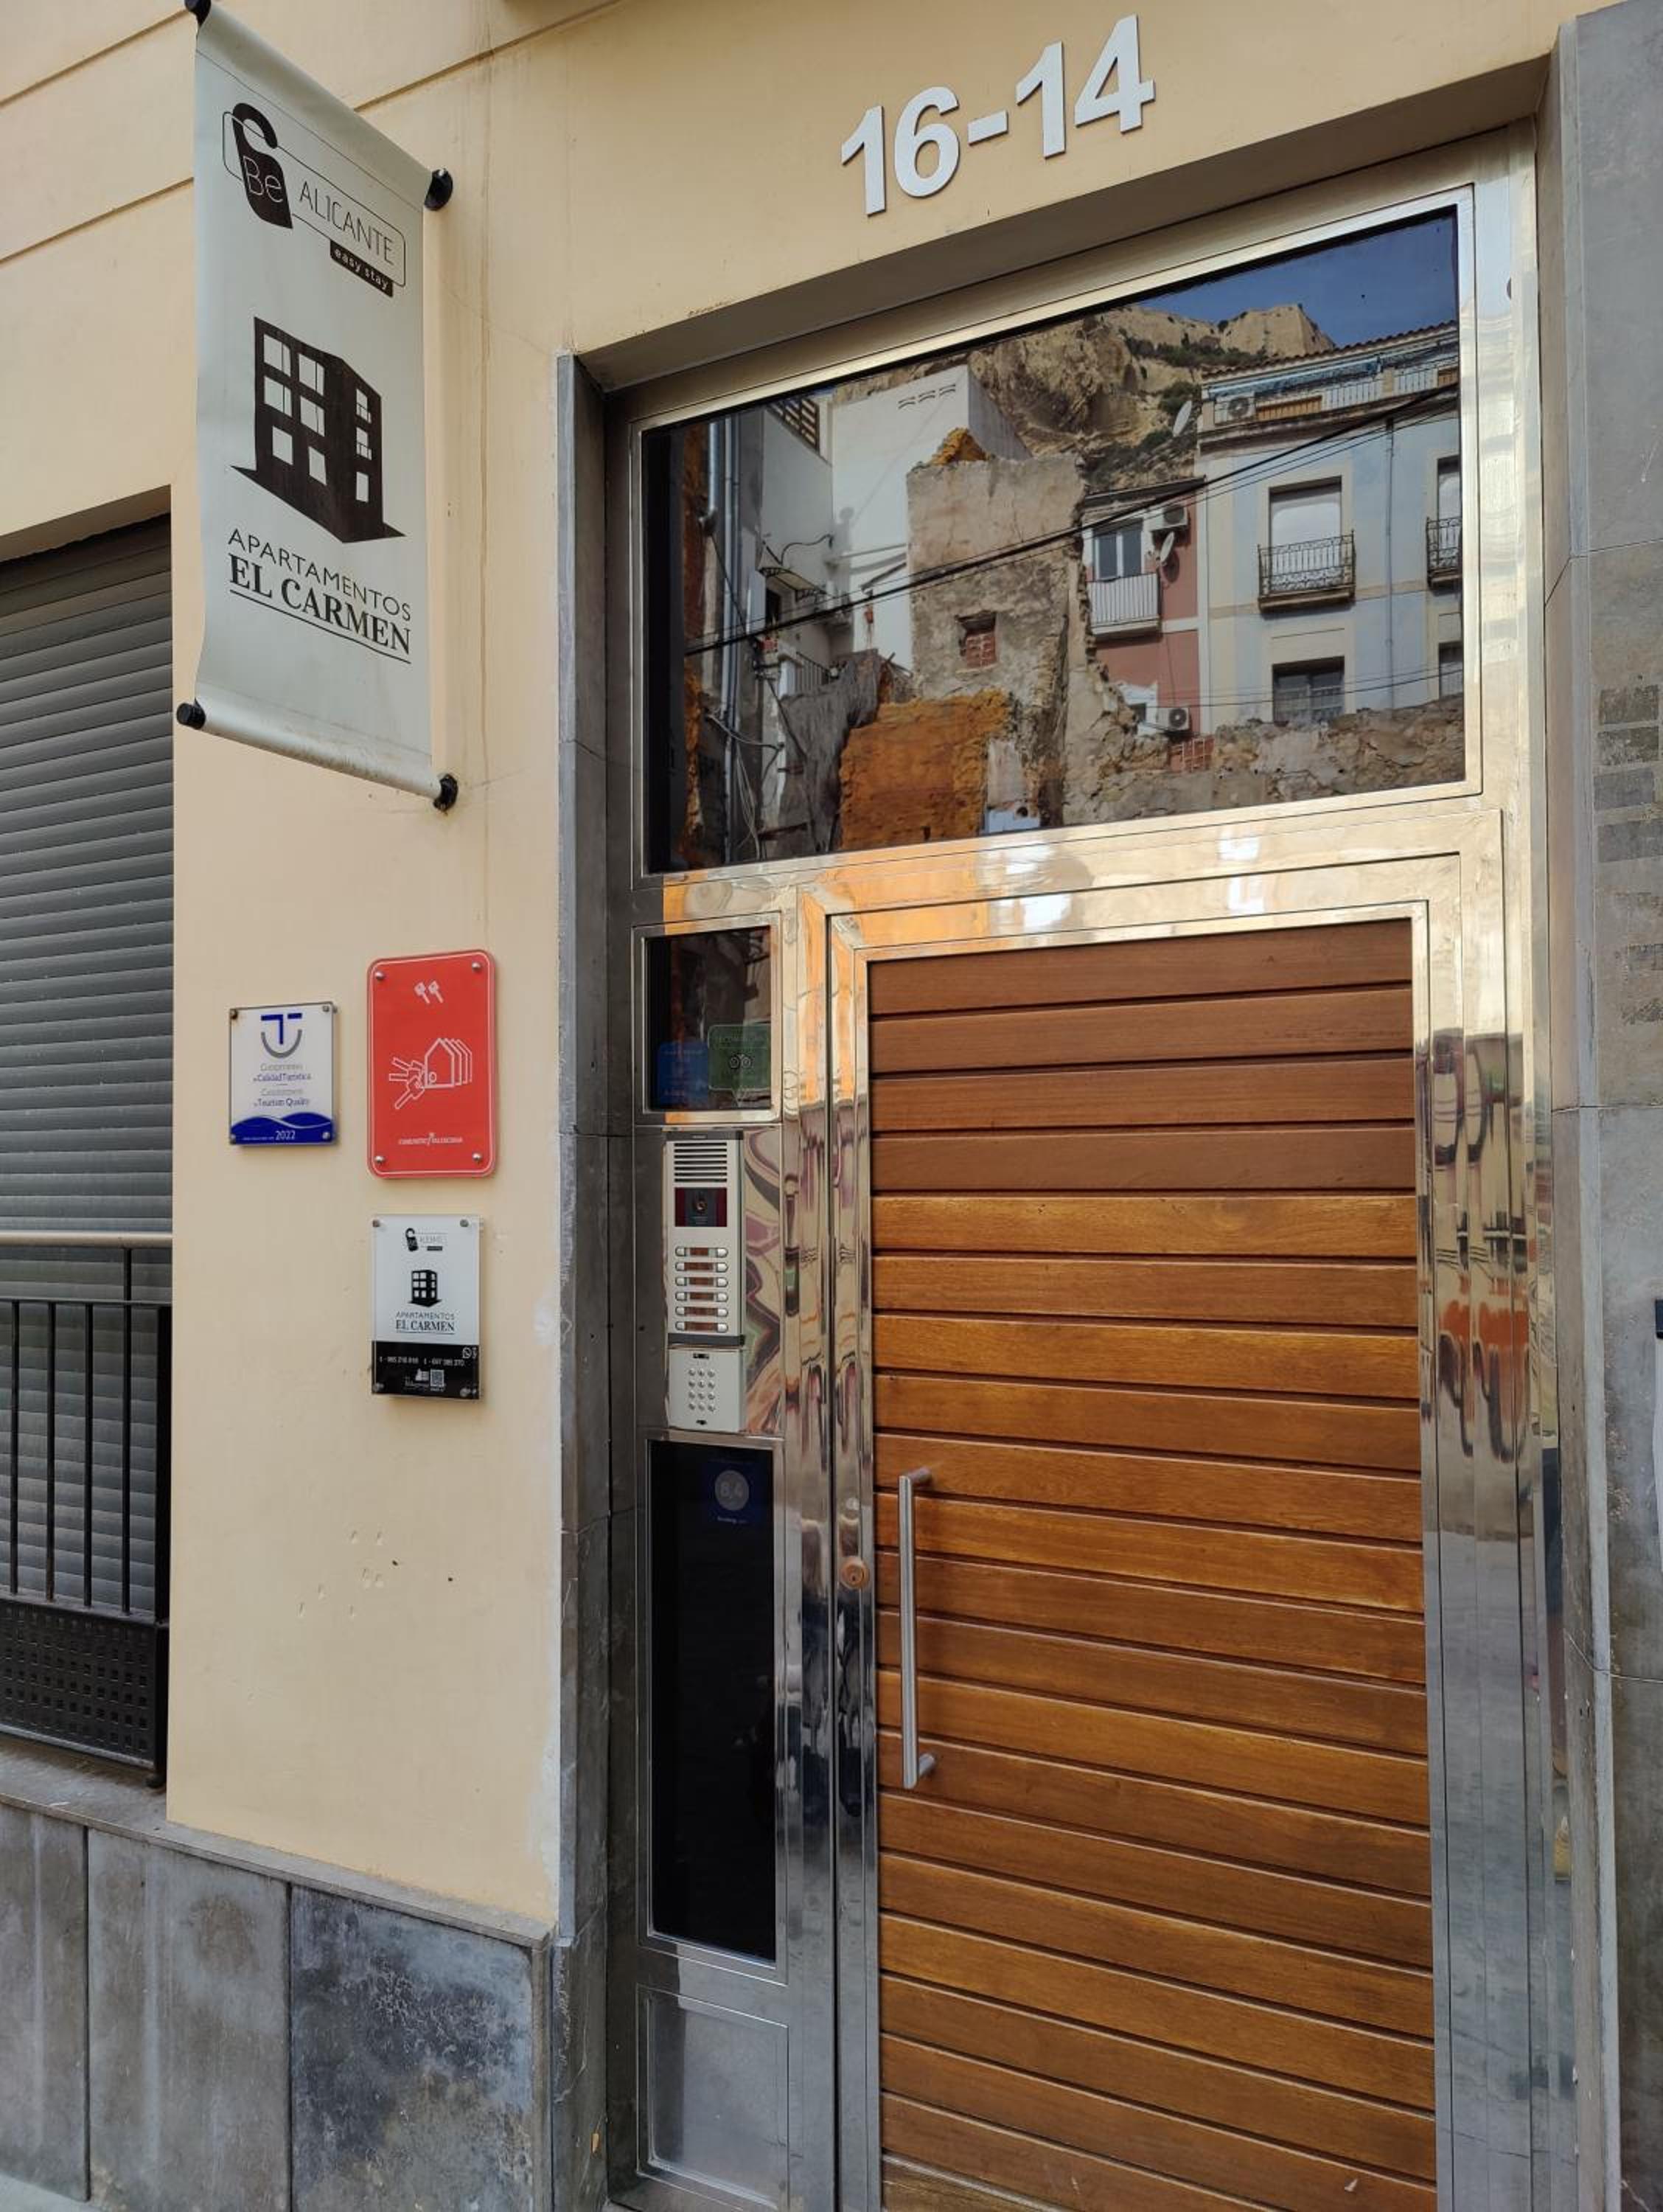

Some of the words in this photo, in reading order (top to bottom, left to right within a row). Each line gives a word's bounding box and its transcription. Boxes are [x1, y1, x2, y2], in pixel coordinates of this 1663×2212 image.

[841, 13, 1156, 217] 16-14
[243, 156, 284, 203] Be
[299, 181, 394, 266] ALICANTE
[334, 248, 361, 273] easy
[365, 268, 388, 290] stay
[228, 528, 411, 622] APARTAMENTOS
[228, 552, 273, 598] EL
[281, 577, 411, 655] CARMEN
[396, 1311, 455, 1321] APARTAMENTOS
[396, 1319, 410, 1330] EL
[411, 1321, 455, 1332] CARMEN
